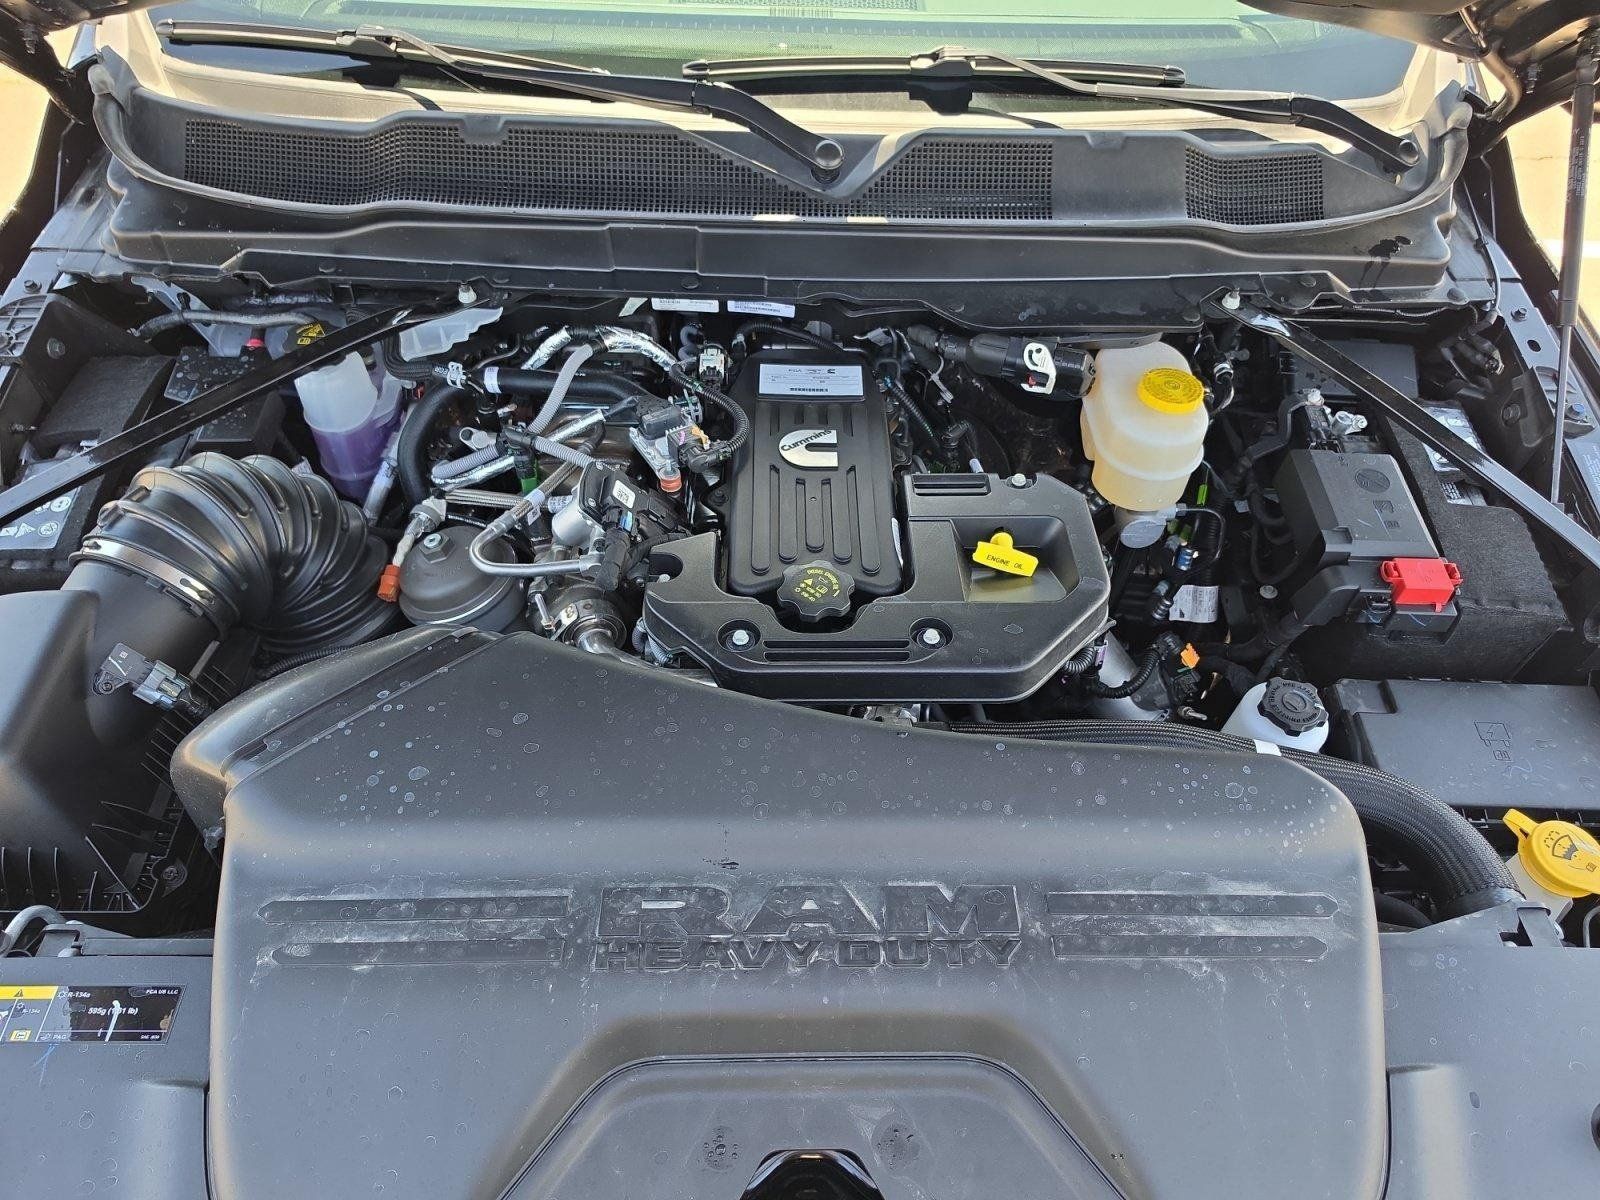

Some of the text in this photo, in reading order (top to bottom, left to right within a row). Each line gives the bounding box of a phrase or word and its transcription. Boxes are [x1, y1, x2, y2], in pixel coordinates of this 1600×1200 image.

[780, 429, 832, 451] Cummins
[986, 554, 1023, 570] ENGINE OIL
[597, 884, 1021, 937] RAM
[594, 938, 1022, 970] HEAVY DUTY
[87, 1007, 106, 1016] 595g
